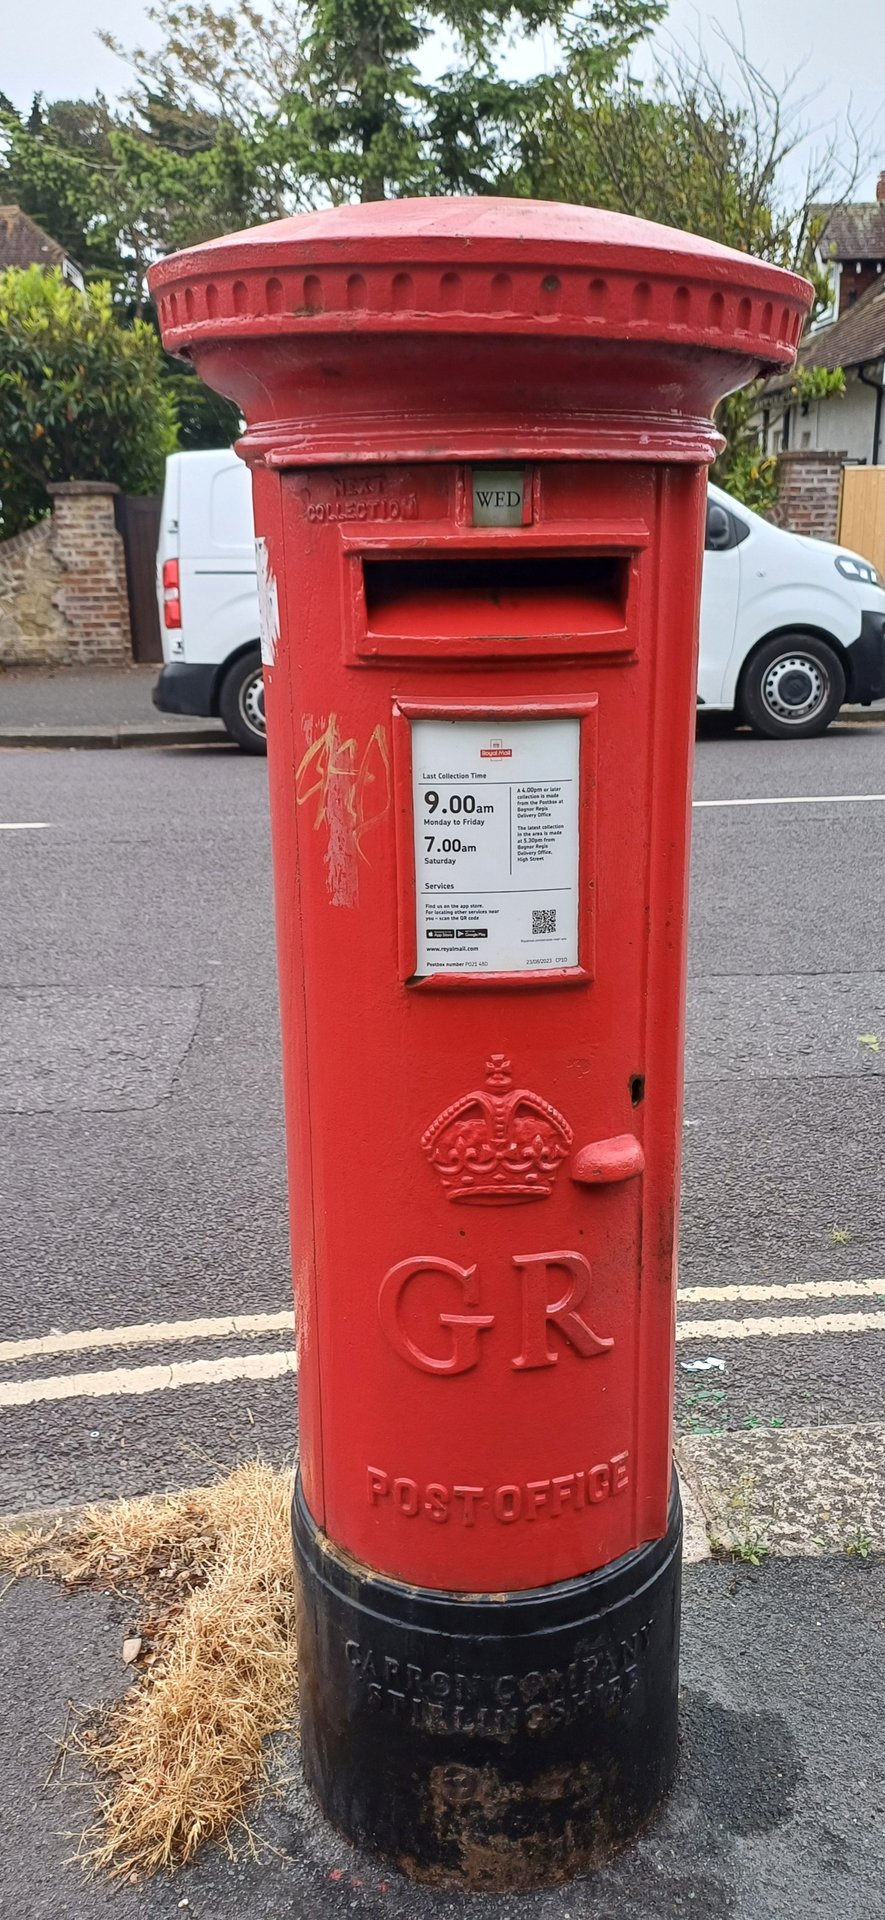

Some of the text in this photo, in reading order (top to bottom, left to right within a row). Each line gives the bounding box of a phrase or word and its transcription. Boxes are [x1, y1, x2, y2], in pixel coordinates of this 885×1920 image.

[333, 476, 387, 497] NEXT
[307, 493, 419, 521] COLLECTION
[475, 491, 520, 508] WED
[424, 791, 494, 814] 9.00am
[424, 836, 476, 852] 7.00am
[378, 1250, 614, 1377] GR
[367, 1450, 629, 1527] POST OFFICE
